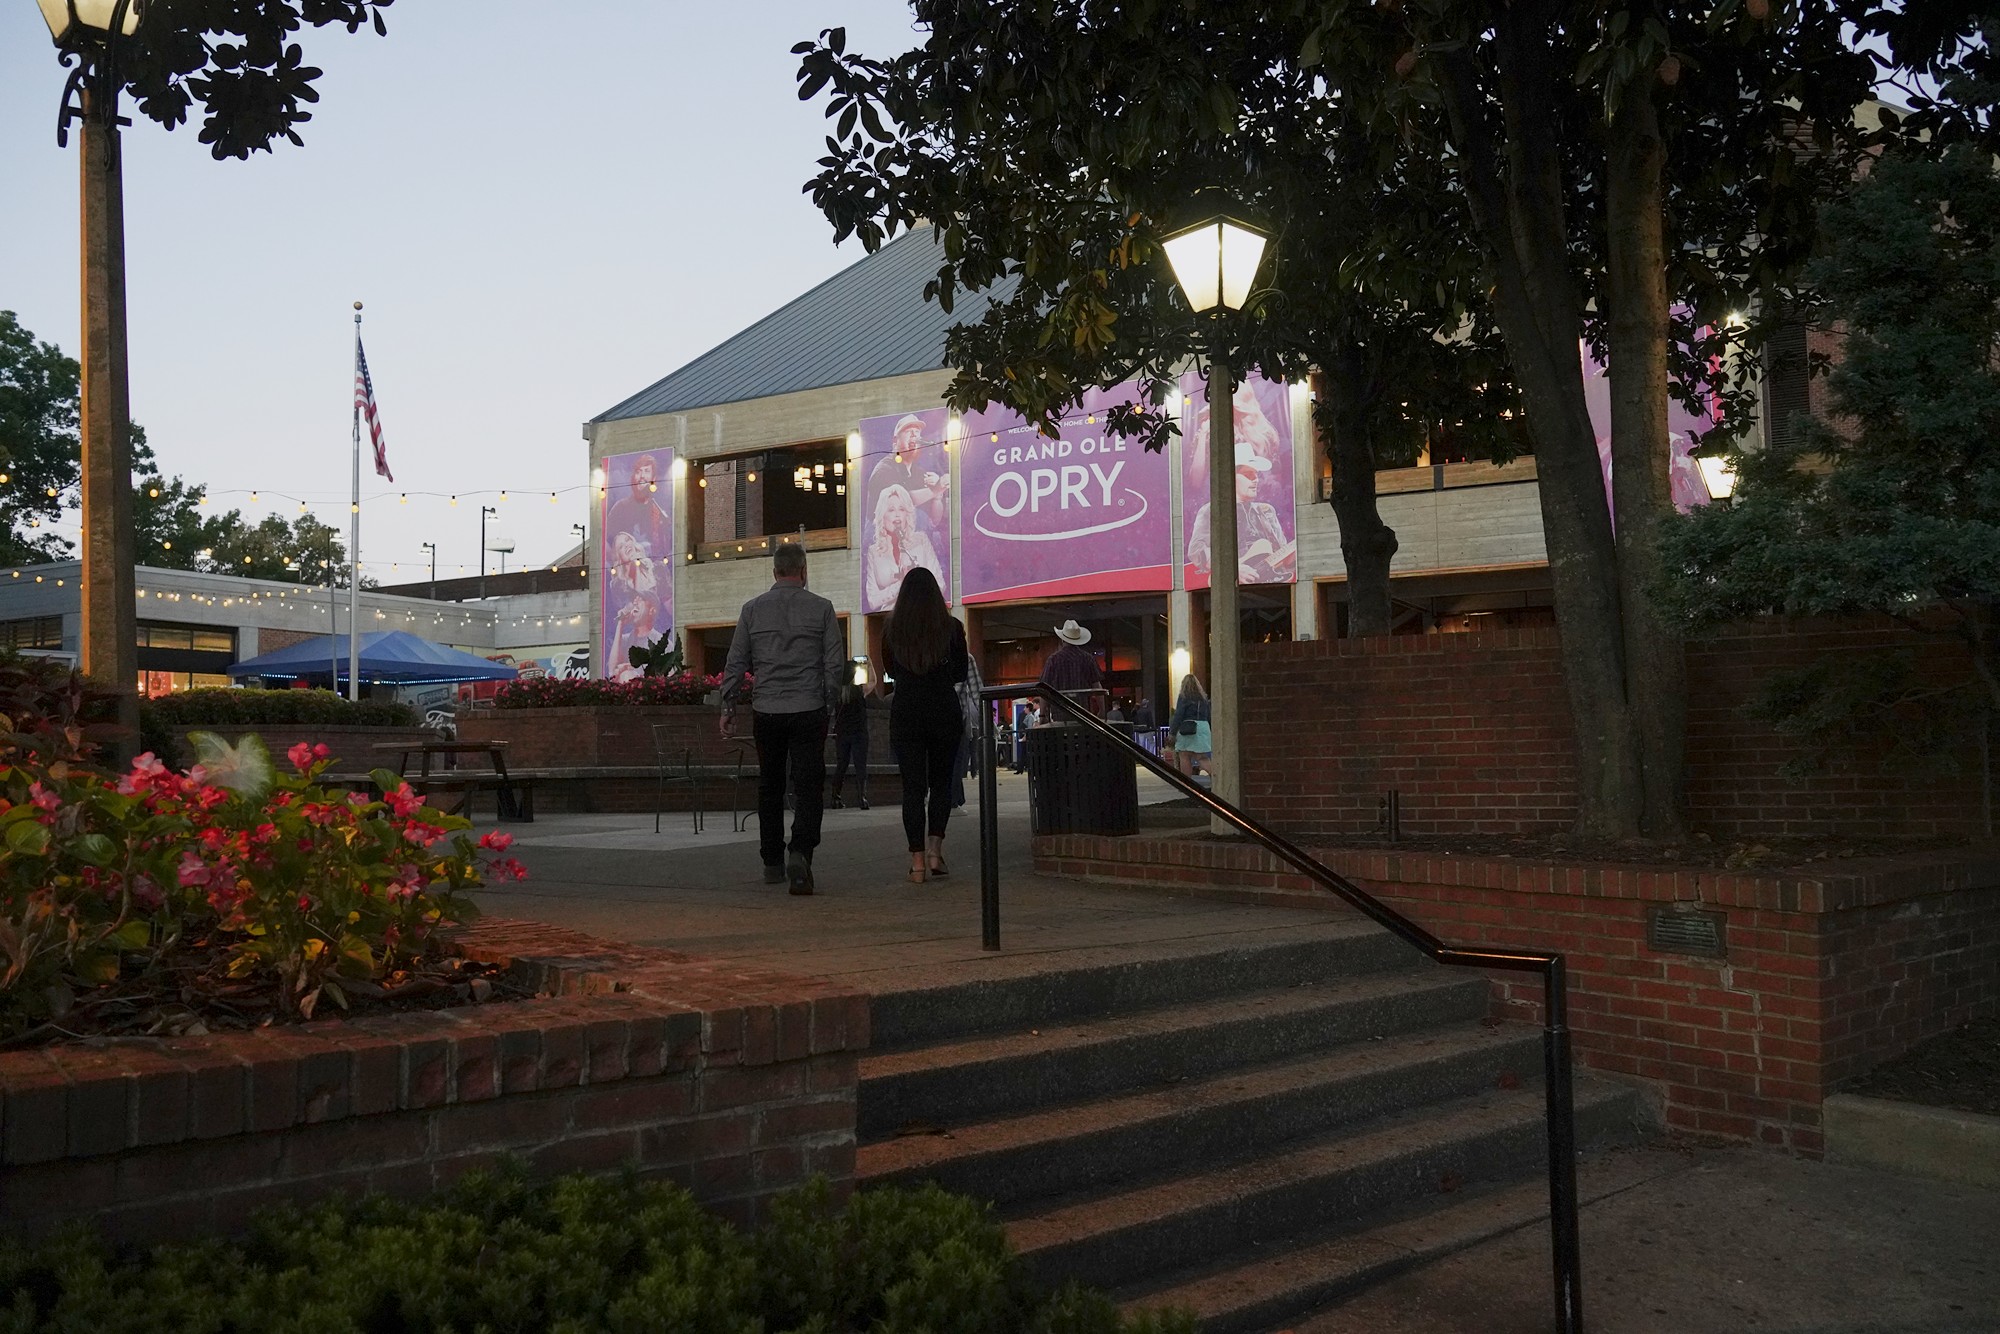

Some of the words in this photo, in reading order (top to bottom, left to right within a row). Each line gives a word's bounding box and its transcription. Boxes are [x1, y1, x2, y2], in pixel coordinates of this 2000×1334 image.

[1063, 419, 1083, 427] HOME
[993, 440, 1073, 466] GRAND
[1079, 434, 1127, 455] OLE
[989, 460, 1127, 518] OPRY
